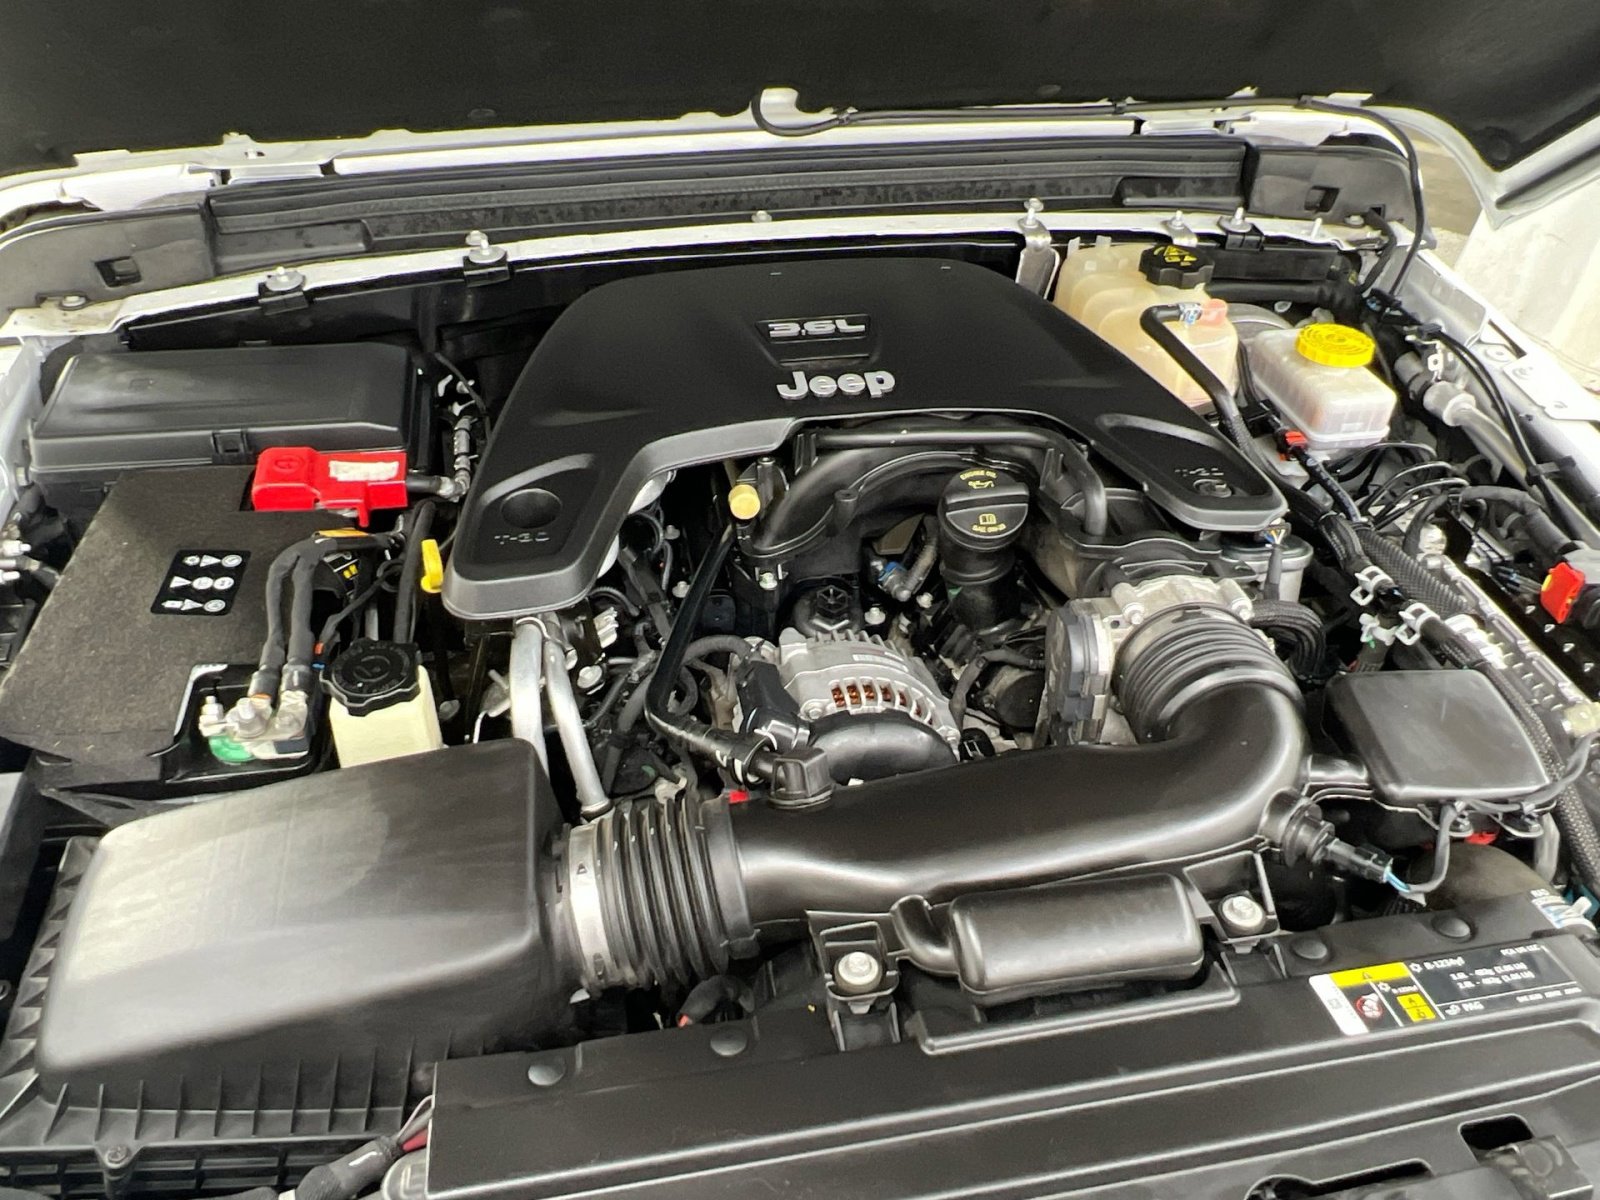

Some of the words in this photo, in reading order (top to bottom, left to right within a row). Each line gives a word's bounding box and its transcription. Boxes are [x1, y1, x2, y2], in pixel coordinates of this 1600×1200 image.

[768, 319, 865, 337] 3.6L
[776, 370, 896, 400] Jeep
[1461, 1001, 1485, 1011] PAG
